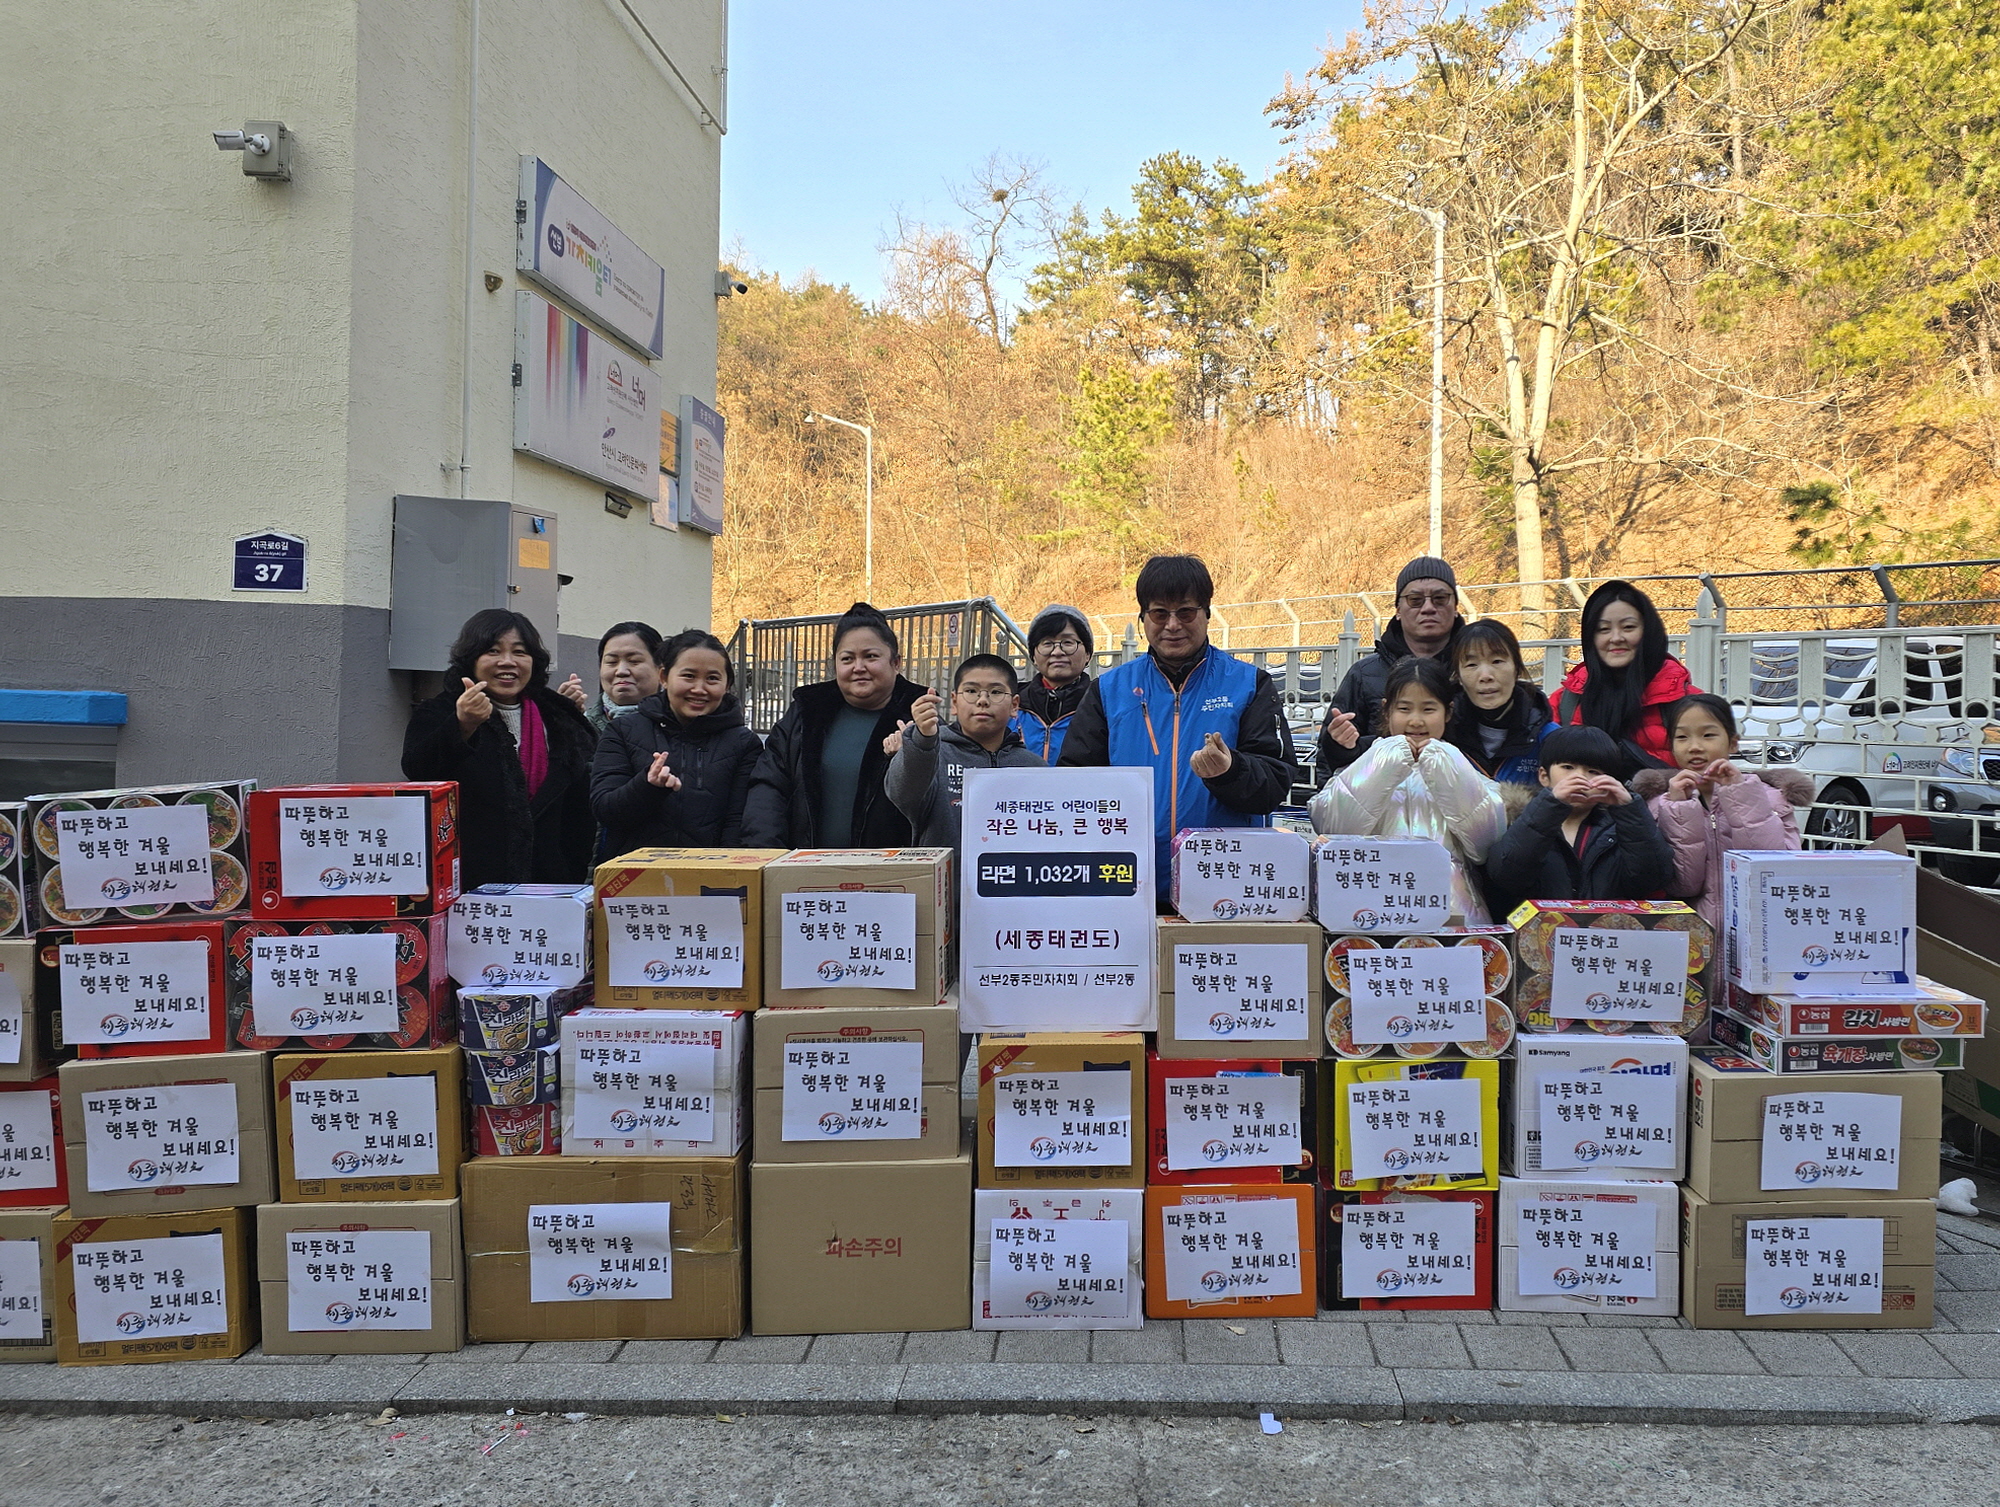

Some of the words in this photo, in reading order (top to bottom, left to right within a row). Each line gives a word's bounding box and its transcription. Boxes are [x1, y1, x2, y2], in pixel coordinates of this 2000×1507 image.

[551, 230, 562, 251] 선부
[566, 237, 611, 297] 가치키움터
[632, 375, 645, 411] 너머
[601, 443, 616, 461] 안산시
[617, 451, 647, 475] 고려인문화센터
[251, 541, 289, 550] 지곡로6길
[254, 564, 283, 582] 37
[948, 764, 963, 776] RE
[284, 805, 350, 825] 따뜻하고
[994, 800, 1055, 814] 세종태권도
[1062, 800, 1121, 813] 어린이들의
[60, 816, 129, 837] 따뜻하고
[987, 818, 1018, 836] 작은
[1028, 820, 1063, 836] 나눔,
[1073, 820, 1088, 835] 큰
[1097, 818, 1128, 835] 행복
[77, 838, 130, 860] 행복한
[138, 836, 171, 856] 겨울
[299, 828, 350, 848] 행복한
[357, 828, 389, 848] 겨울
[1184, 838, 1242, 857] 따뜻하고
[134, 857, 208, 877] 보내세요!
[352, 851, 422, 870] 보내세요!
[1322, 848, 1382, 867] 따뜻하고
[982, 865, 1016, 884] 라면
[1025, 865, 1090, 885] 1,032개
[1099, 864, 1134, 883] 후원
[1196, 860, 1242, 880] 행복한
[1248, 862, 1276, 882] 겨울
[1335, 870, 1381, 890] 행복한
[1388, 871, 1417, 890] 겨울
[1242, 885, 1306, 903] 보내세요!
[1383, 894, 1447, 912] 보내세요!
[1770, 883, 1831, 903] 따뜻하고
[607, 903, 671, 920] 따뜻하고
[786, 899, 847, 918] 따뜻하고
[1783, 906, 1831, 926] 행복한
[1838, 907, 1867, 926] 겨울
[624, 922, 672, 942] 행복한
[679, 923, 708, 942] 겨울
[799, 921, 847, 942] 행복한
[854, 922, 882, 942] 겨울
[995, 929, 1120, 951] (세종태권도)
[1833, 930, 1899, 947] 보내세요!
[1559, 934, 1619, 952] 따뜻하고
[257, 943, 321, 964] 따뜻하고
[674, 946, 740, 964] 보내세요!
[848, 945, 912, 965] 보내세요!
[1178, 951, 1238, 971] 따뜻하고
[1571, 955, 1617, 975] 행복한
[1624, 958, 1653, 977] 겨울
[270, 967, 320, 988] 행복한
[327, 966, 358, 987] 겨울
[979, 973, 1078, 987] 선부2동주민자치회
[1094, 972, 1135, 987] 선부2동
[1191, 973, 1238, 993] 행복한
[1245, 974, 1274, 994] 겨울
[323, 988, 393, 1007] 보내세요!
[1617, 979, 1683, 999] 보내세요!
[1239, 997, 1304, 1016] 보내세요!
[1811, 1010, 1830, 1020] 농심
[482, 1007, 527, 1030] 진라면
[579, 1048, 642, 1067] 따뜻하고
[788, 1050, 851, 1070] 따뜻하고
[1539, 1049, 1570, 1057] Samyang
[1801, 1046, 1819, 1056] 농심
[487, 1061, 533, 1084] 진라면
[592, 1071, 641, 1091] 행복한
[648, 1073, 678, 1093] 겨울
[801, 1073, 850, 1093] 행복한
[857, 1073, 887, 1094] 겨울
[998, 1078, 1060, 1096] 따뜻하고
[1169, 1083, 1230, 1101] 따뜻하고
[1544, 1081, 1603, 1101] 따뜻하고
[87, 1096, 158, 1117] 따뜻하고
[295, 1088, 360, 1109] 따뜻하고
[642, 1095, 710, 1115] 보내세요!
[850, 1096, 918, 1115] 보내세요!
[1011, 1097, 1060, 1117] 행복한
[1066, 1097, 1096, 1117] 겨울
[1182, 1102, 1230, 1122] 행복한
[1236, 1101, 1266, 1120] 겨울
[1556, 1103, 1603, 1123] 행복한
[1609, 1103, 1640, 1123] 겨울
[1769, 1100, 1825, 1120] 따뜻하고
[105, 1118, 158, 1141] 행복한
[166, 1116, 199, 1137] 겨울
[310, 1111, 361, 1132] 행복한
[368, 1109, 399, 1130] 겨울
[493, 1114, 539, 1137] 진라면
[1061, 1120, 1127, 1139] 보내세요!
[363, 1131, 434, 1151] 보내세요!
[1232, 1122, 1298, 1140] 보내세요!
[1604, 1126, 1672, 1145] 보내세요!
[1778, 1122, 1824, 1142] 행복한
[1831, 1123, 1862, 1142] 겨울
[162, 1138, 235, 1158] 보내세요!
[1825, 1146, 1895, 1166] 보내세요!
[532, 1213, 595, 1234] 따뜻하고
[1166, 1210, 1227, 1231] 따뜻하고
[1346, 1210, 1406, 1229] 따뜻하고
[546, 1236, 596, 1255] 행복한
[603, 1236, 634, 1254] 겨울
[995, 1227, 1056, 1247] 따뜻하고
[1180, 1232, 1228, 1253] 행복한
[1235, 1231, 1264, 1251] 겨울
[1358, 1231, 1405, 1251] 행복한
[1412, 1231, 1440, 1251] 겨울
[1750, 1226, 1811, 1245] 따뜻하고
[825, 1236, 902, 1258] 파손주의
[76, 1249, 144, 1271] 따뜻하고
[599, 1256, 668, 1275] 보내세요!
[1008, 1251, 1056, 1273] 행복한
[1063, 1253, 1092, 1274] 겨울
[1231, 1252, 1297, 1271] 보내세요!
[1406, 1254, 1471, 1272] 보내세요!
[1762, 1248, 1810, 1268] 행복한
[1817, 1249, 1847, 1269] 겨울
[93, 1271, 145, 1294] 행복한
[153, 1268, 186, 1289] 겨울
[1056, 1277, 1124, 1295] 보내세요!
[1811, 1272, 1879, 1290] 보내세요!
[149, 1288, 222, 1311] 보내세요!
